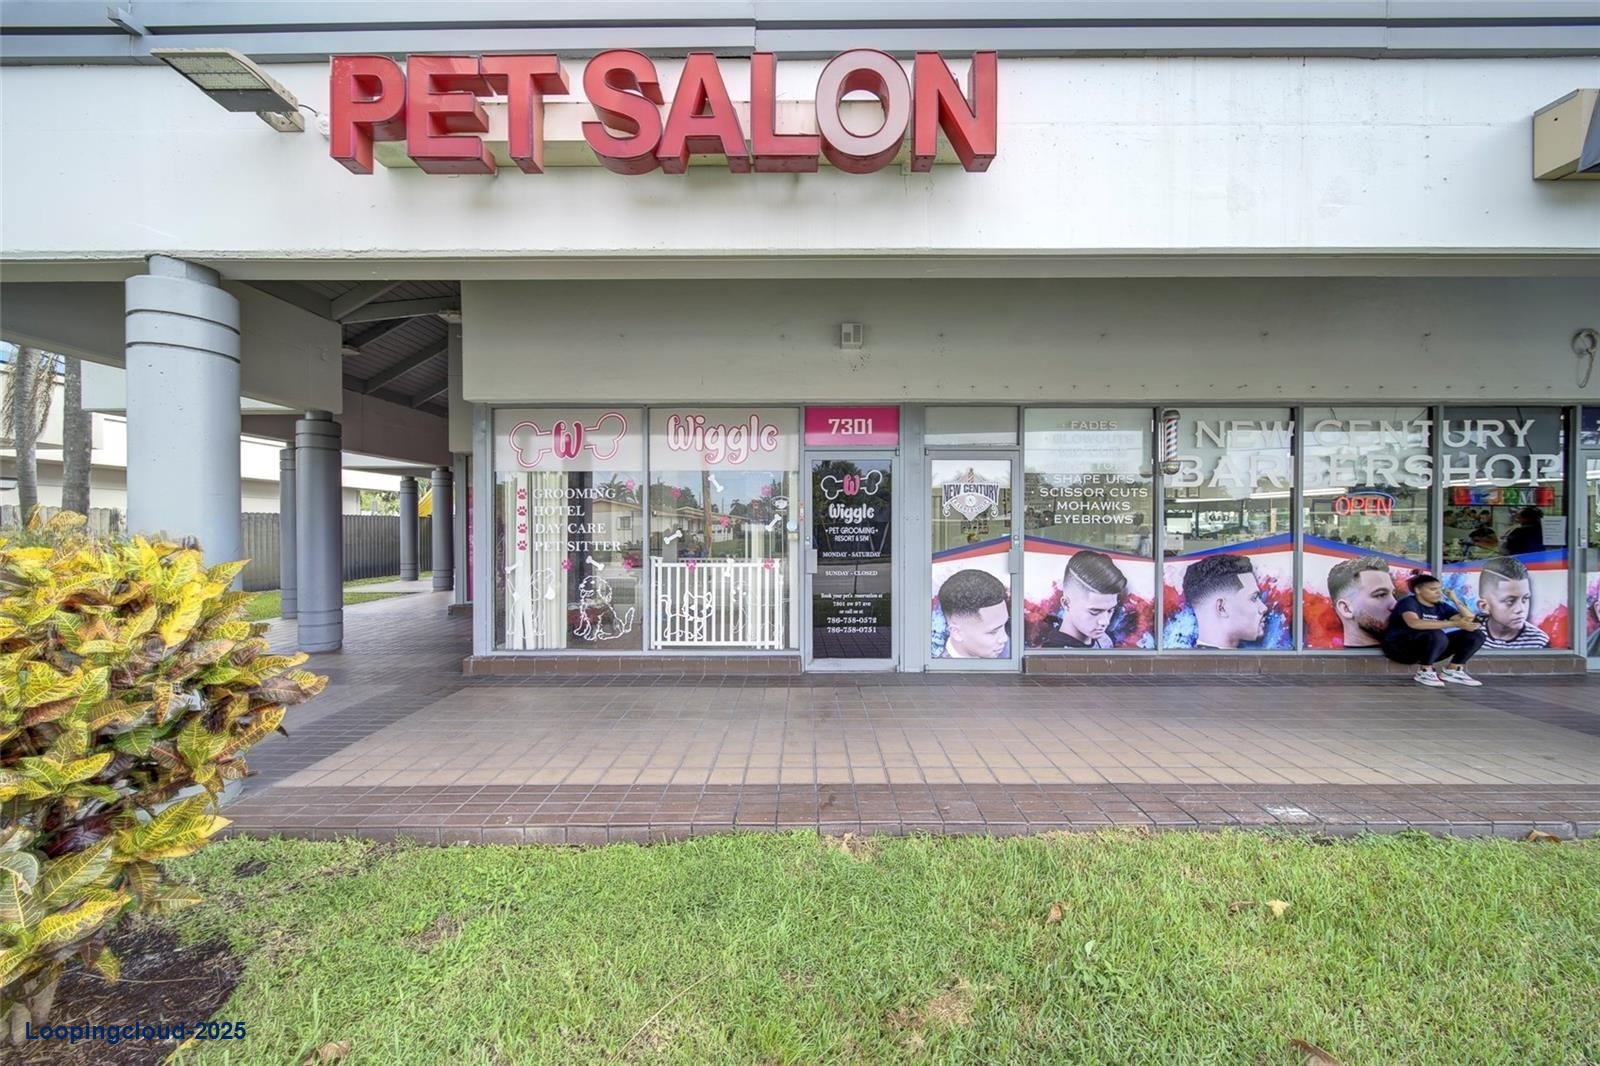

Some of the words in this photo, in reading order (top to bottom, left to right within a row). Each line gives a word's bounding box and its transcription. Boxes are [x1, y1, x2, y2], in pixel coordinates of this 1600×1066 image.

[330, 53, 569, 175] PET
[582, 48, 997, 175] SALON
[828, 418, 873, 435] 7301
[1071, 420, 1118, 430] FADES
[666, 414, 779, 464] Wiggle
[1195, 420, 1295, 448] NEW
[1313, 419, 1536, 449] CENTURY
[1053, 474, 1101, 484] SHAPE
[1106, 474, 1135, 484] UPS
[532, 487, 616, 499] GROOMING
[943, 484, 961, 505] NEW
[963, 484, 999, 504] CENTURY
[1040, 487, 1105, 498] SCISSOR
[1109, 487, 1148, 498] CUTS
[533, 505, 585, 517] HOTEL
[1056, 501, 1131, 511] MOHAWKS
[1334, 495, 1393, 516] OPEN
[828, 503, 875, 524] Wiggle
[1054, 514, 1134, 524] EYEBROWS
[534, 522, 567, 534] DAY
[567, 522, 607, 534] CARE
[828, 526, 839, 534] PET
[840, 526, 875, 534] GROOMING
[535, 541, 566, 551] PET
[567, 541, 621, 551] SITTER
